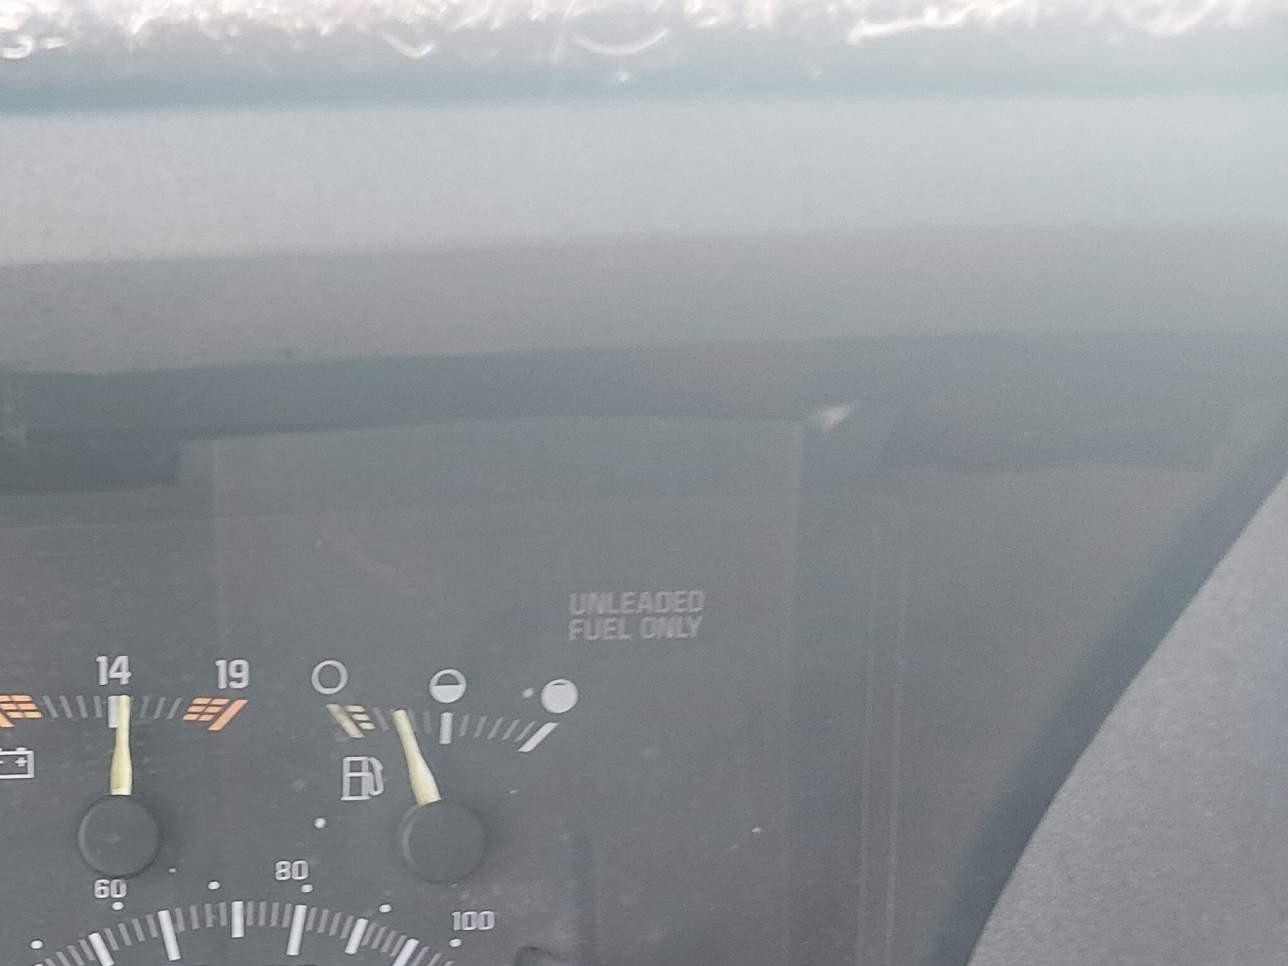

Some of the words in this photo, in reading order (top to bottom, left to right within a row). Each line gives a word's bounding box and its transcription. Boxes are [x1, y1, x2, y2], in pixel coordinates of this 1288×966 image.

[568, 591, 706, 615] UNLEADED
[568, 617, 632, 640] FUEL
[639, 615, 703, 639] ONLY
[96, 655, 131, 686] 14
[215, 659, 250, 689] 19
[275, 861, 308, 880] 80
[94, 879, 127, 898] 60
[451, 911, 495, 930] 100
